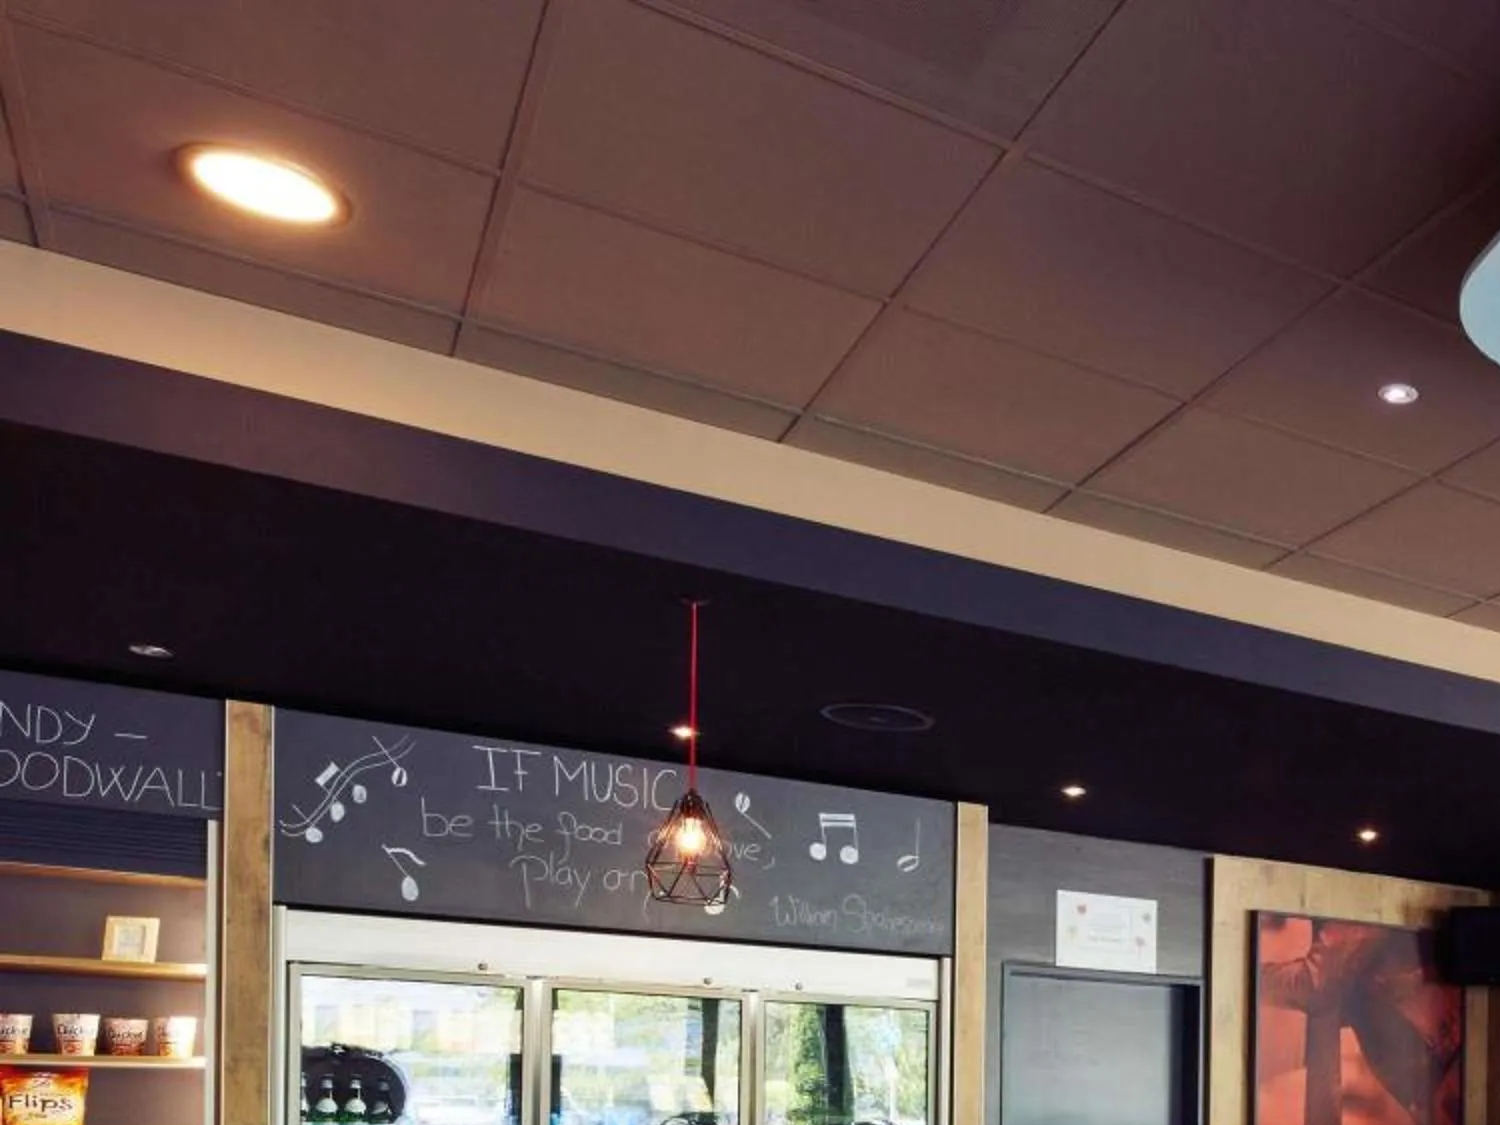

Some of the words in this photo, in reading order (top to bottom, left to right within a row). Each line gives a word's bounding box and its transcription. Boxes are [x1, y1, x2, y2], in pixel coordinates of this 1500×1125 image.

[472, 745, 542, 792] IF
[553, 755, 678, 812] MUSIC
[421, 797, 474, 837] be
[488, 804, 544, 850] the
[556, 811, 623, 865] food
